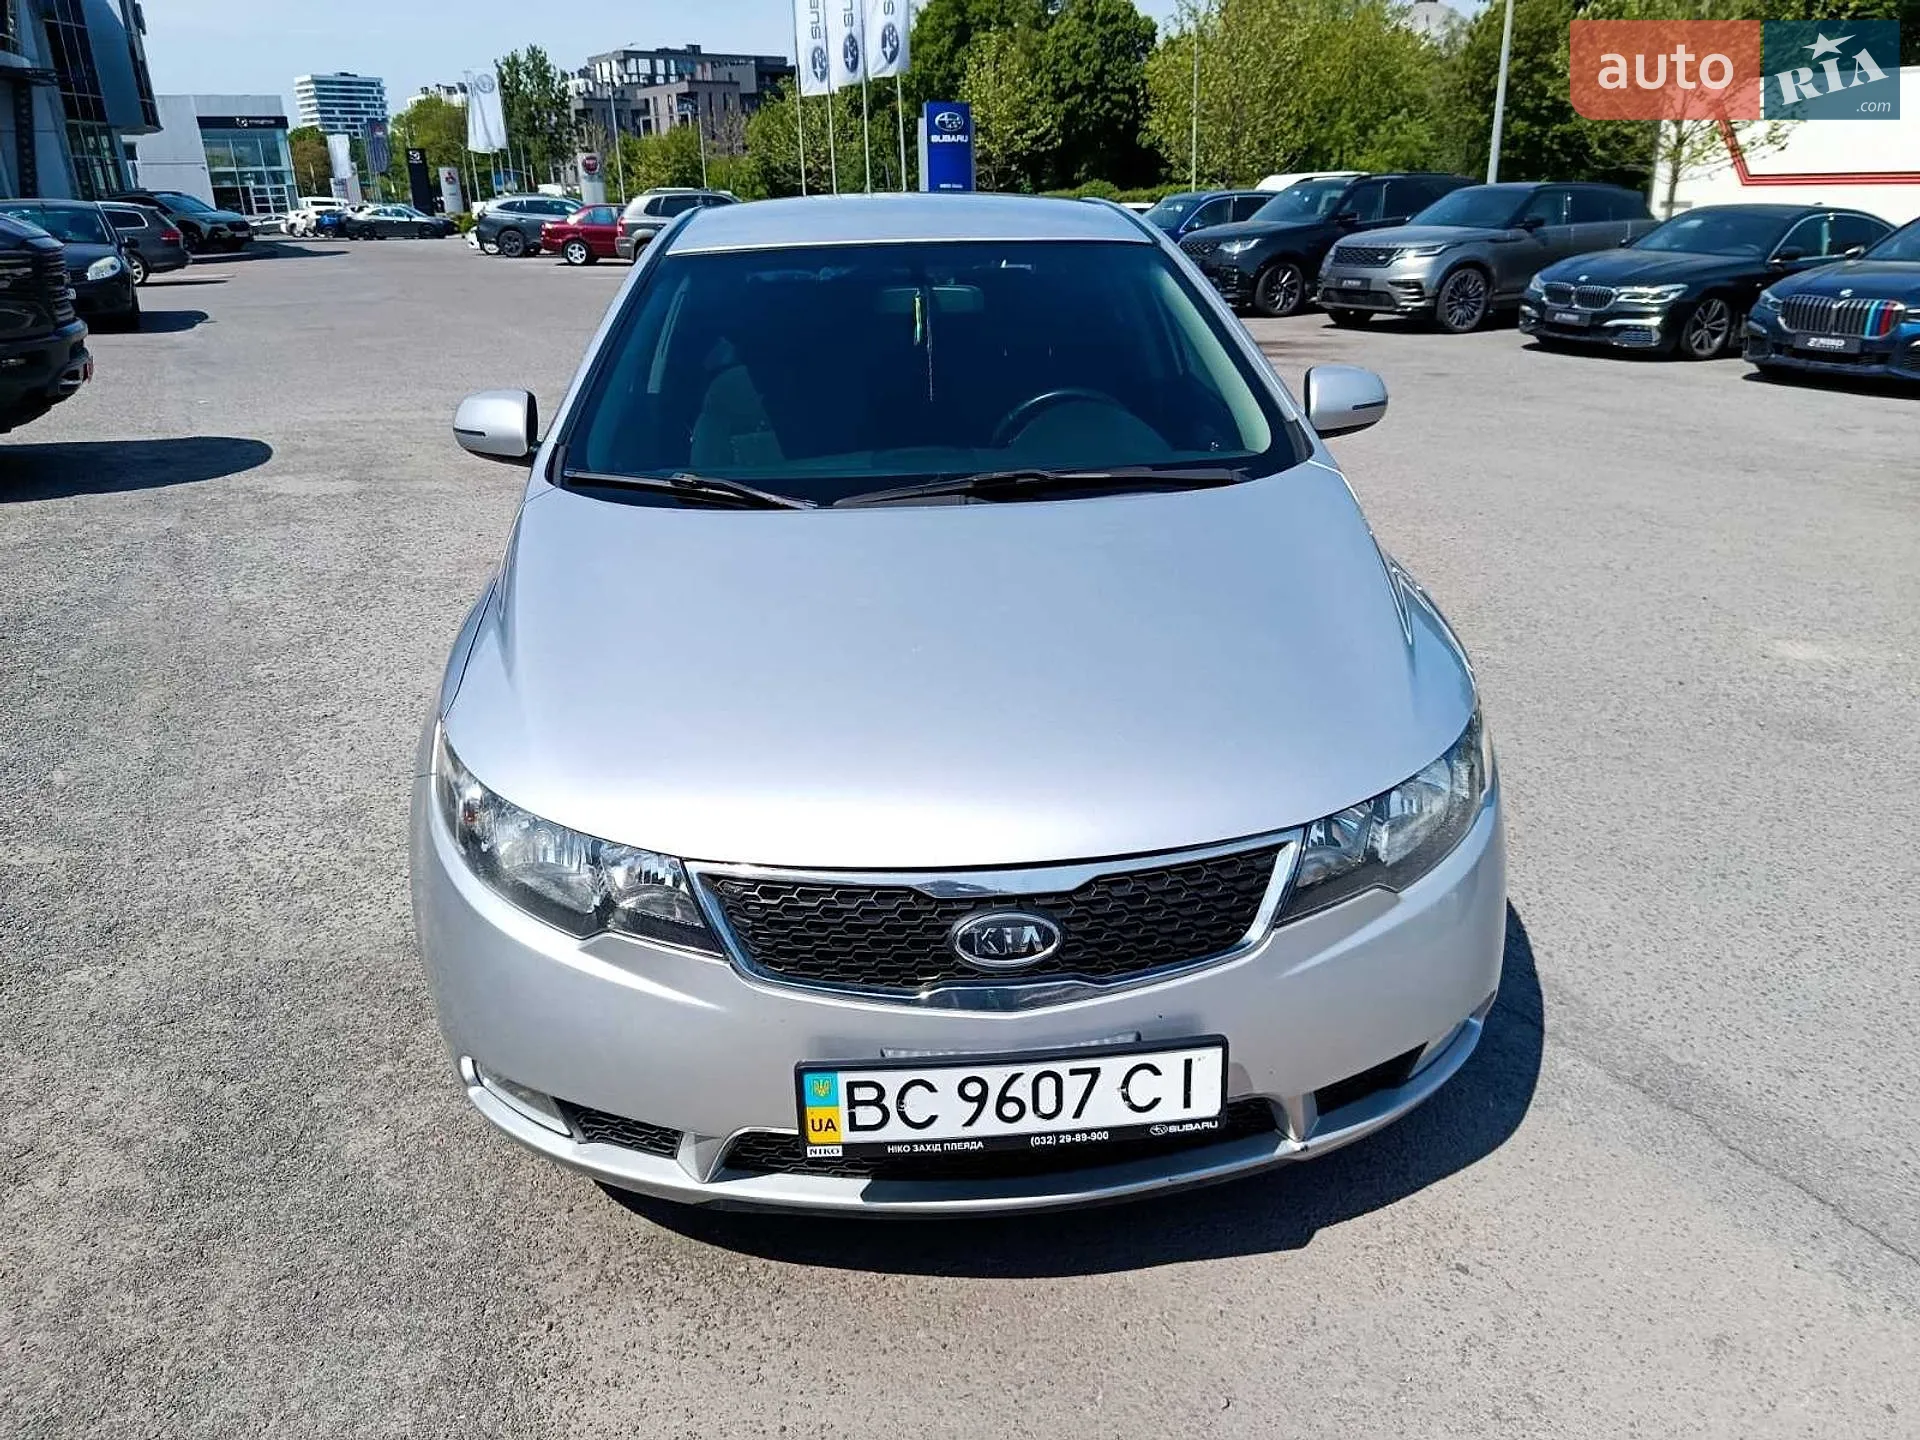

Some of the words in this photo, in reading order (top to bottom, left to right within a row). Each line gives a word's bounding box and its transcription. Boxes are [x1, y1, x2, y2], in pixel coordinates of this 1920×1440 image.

[973, 925, 1044, 955] KIA
[846, 1079, 939, 1132] BC
[957, 1066, 1101, 1127] 9607
[811, 1119, 837, 1132] UA
[1168, 1121, 1218, 1133] SUBARU
[1030, 1135, 1056, 1147] (032)
[1059, 1131, 1109, 1144] 29-89-900
[809, 1147, 840, 1156] NIKO
[887, 1145, 911, 1153] НІКО
[913, 1143, 941, 1152] ЗАХІД
